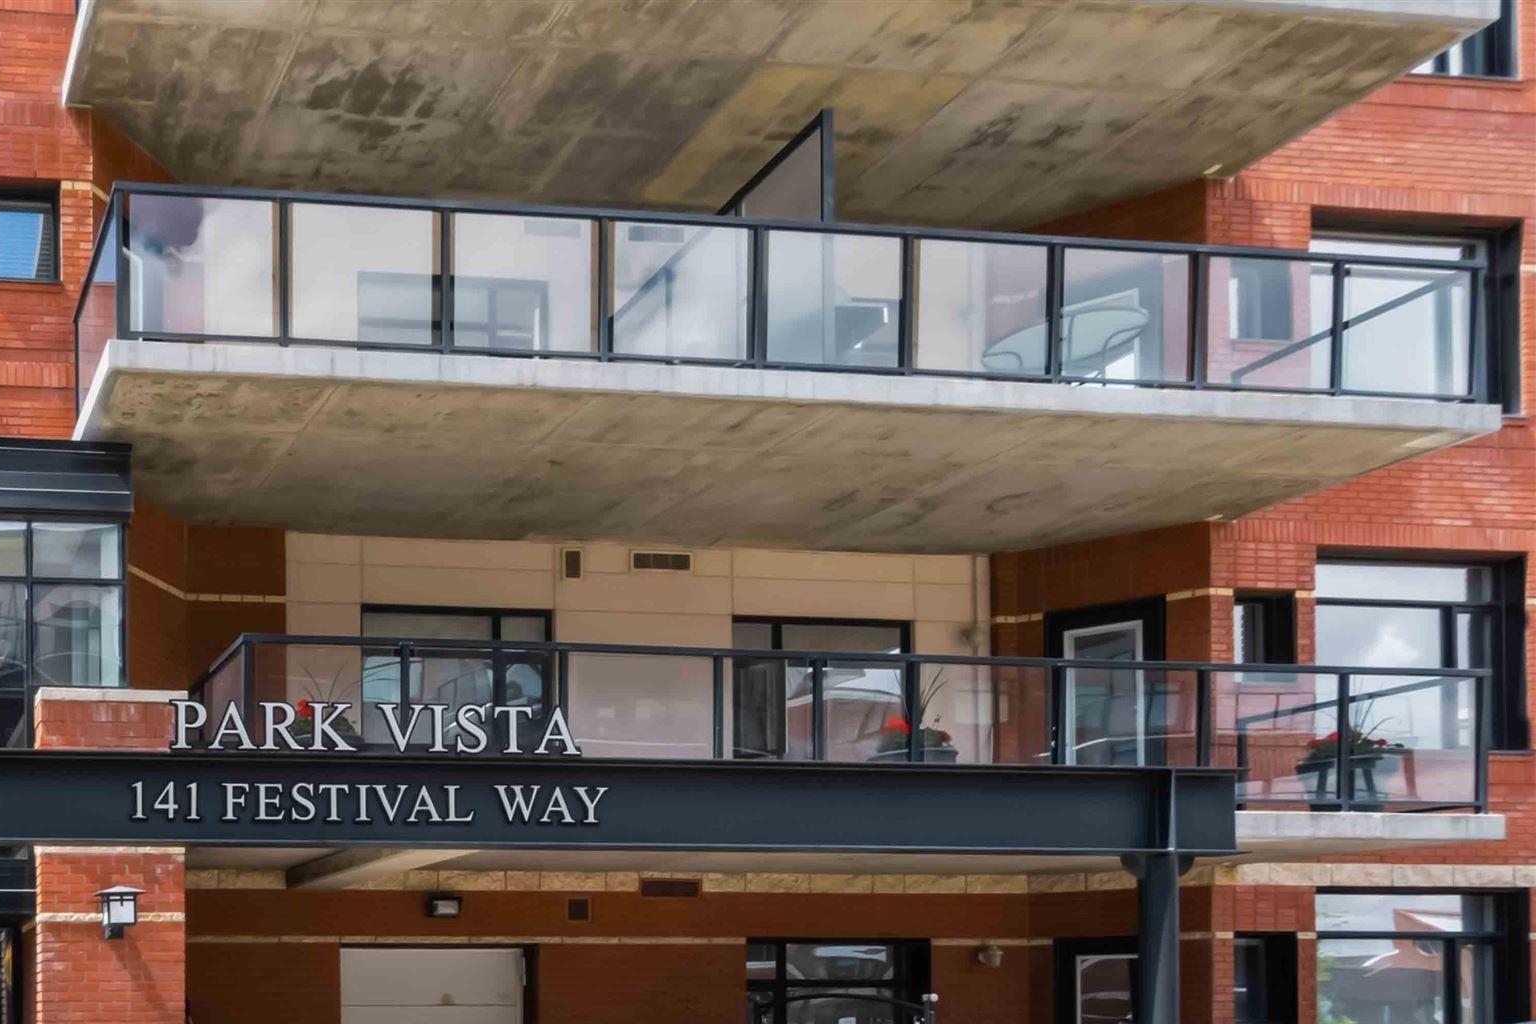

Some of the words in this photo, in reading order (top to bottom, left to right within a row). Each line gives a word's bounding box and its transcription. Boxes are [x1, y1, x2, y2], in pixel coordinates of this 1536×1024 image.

[170, 699, 357, 752] PARK
[378, 702, 582, 755] VISTA
[130, 781, 200, 820] 141
[221, 783, 474, 823] FESTIVAL
[495, 785, 609, 824] WAY
